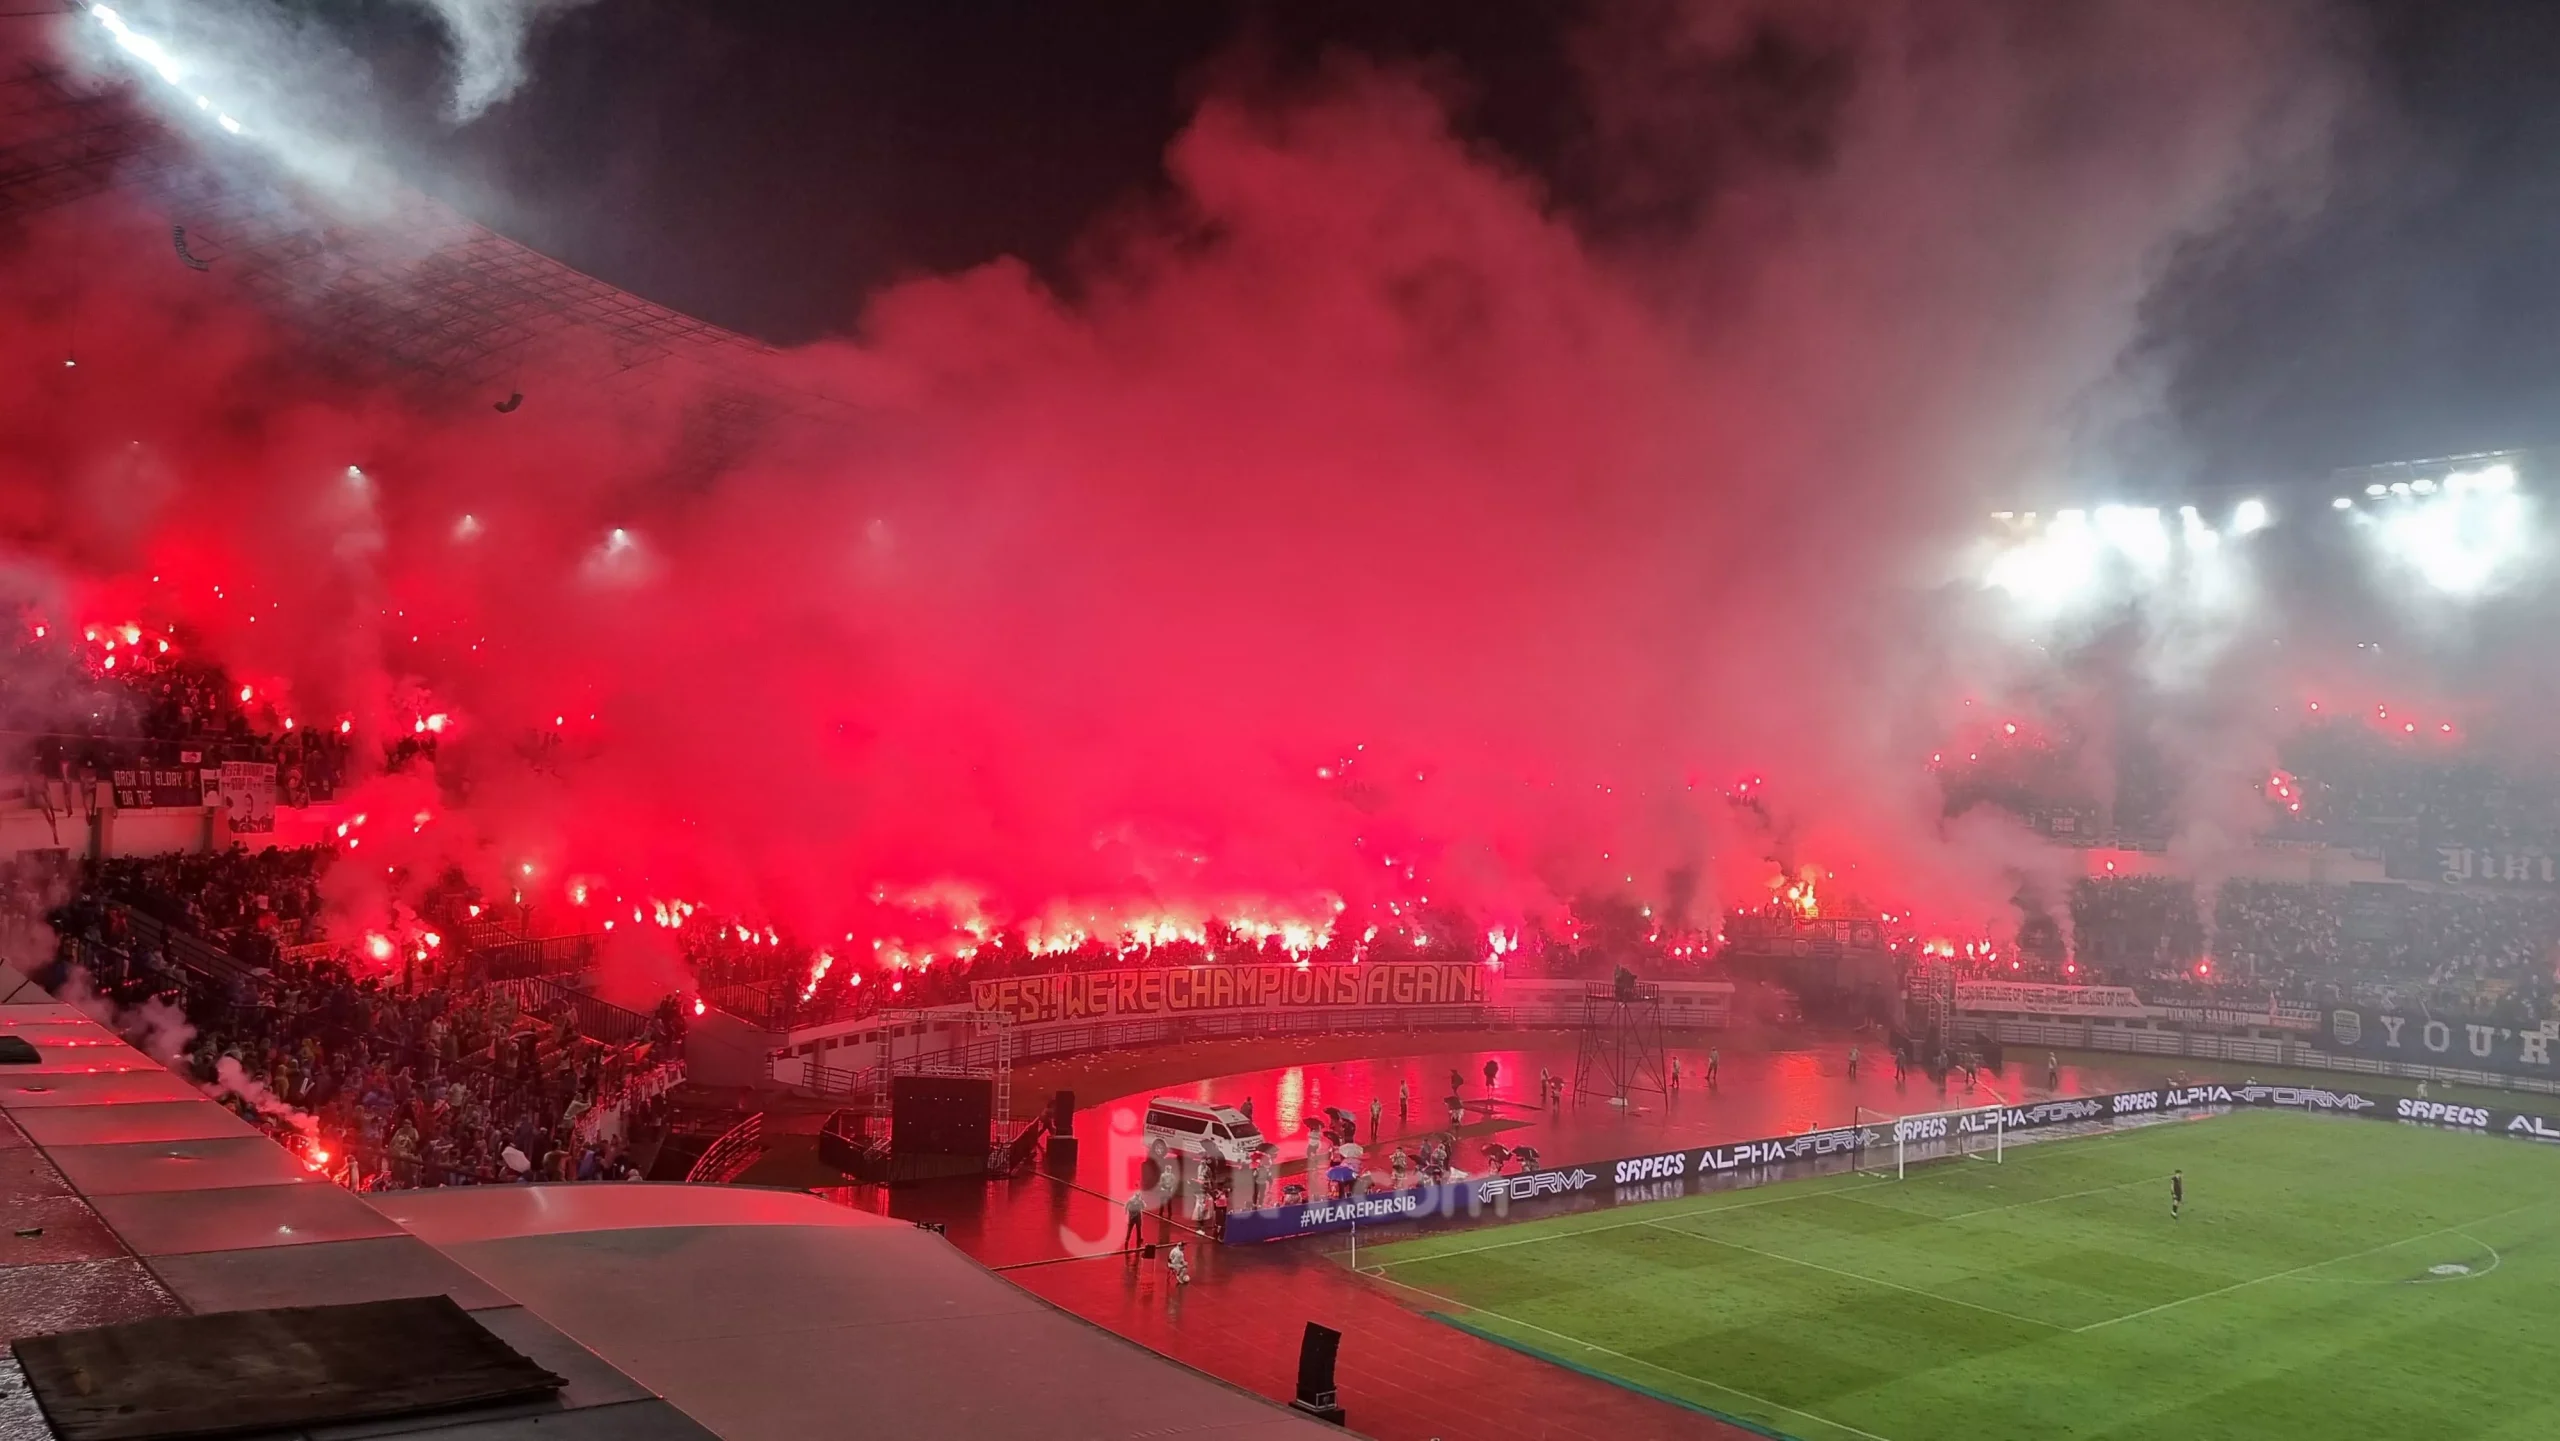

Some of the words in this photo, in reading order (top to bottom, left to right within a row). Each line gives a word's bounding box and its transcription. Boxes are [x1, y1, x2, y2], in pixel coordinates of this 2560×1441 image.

[1168, 964, 1362, 1010] CHAMPIONS
[2165, 1085, 2232, 1106] ALPHA
[1698, 1141, 1786, 1171] ALPHA
[1300, 1195, 1417, 1228] #WEAREPERSIB
